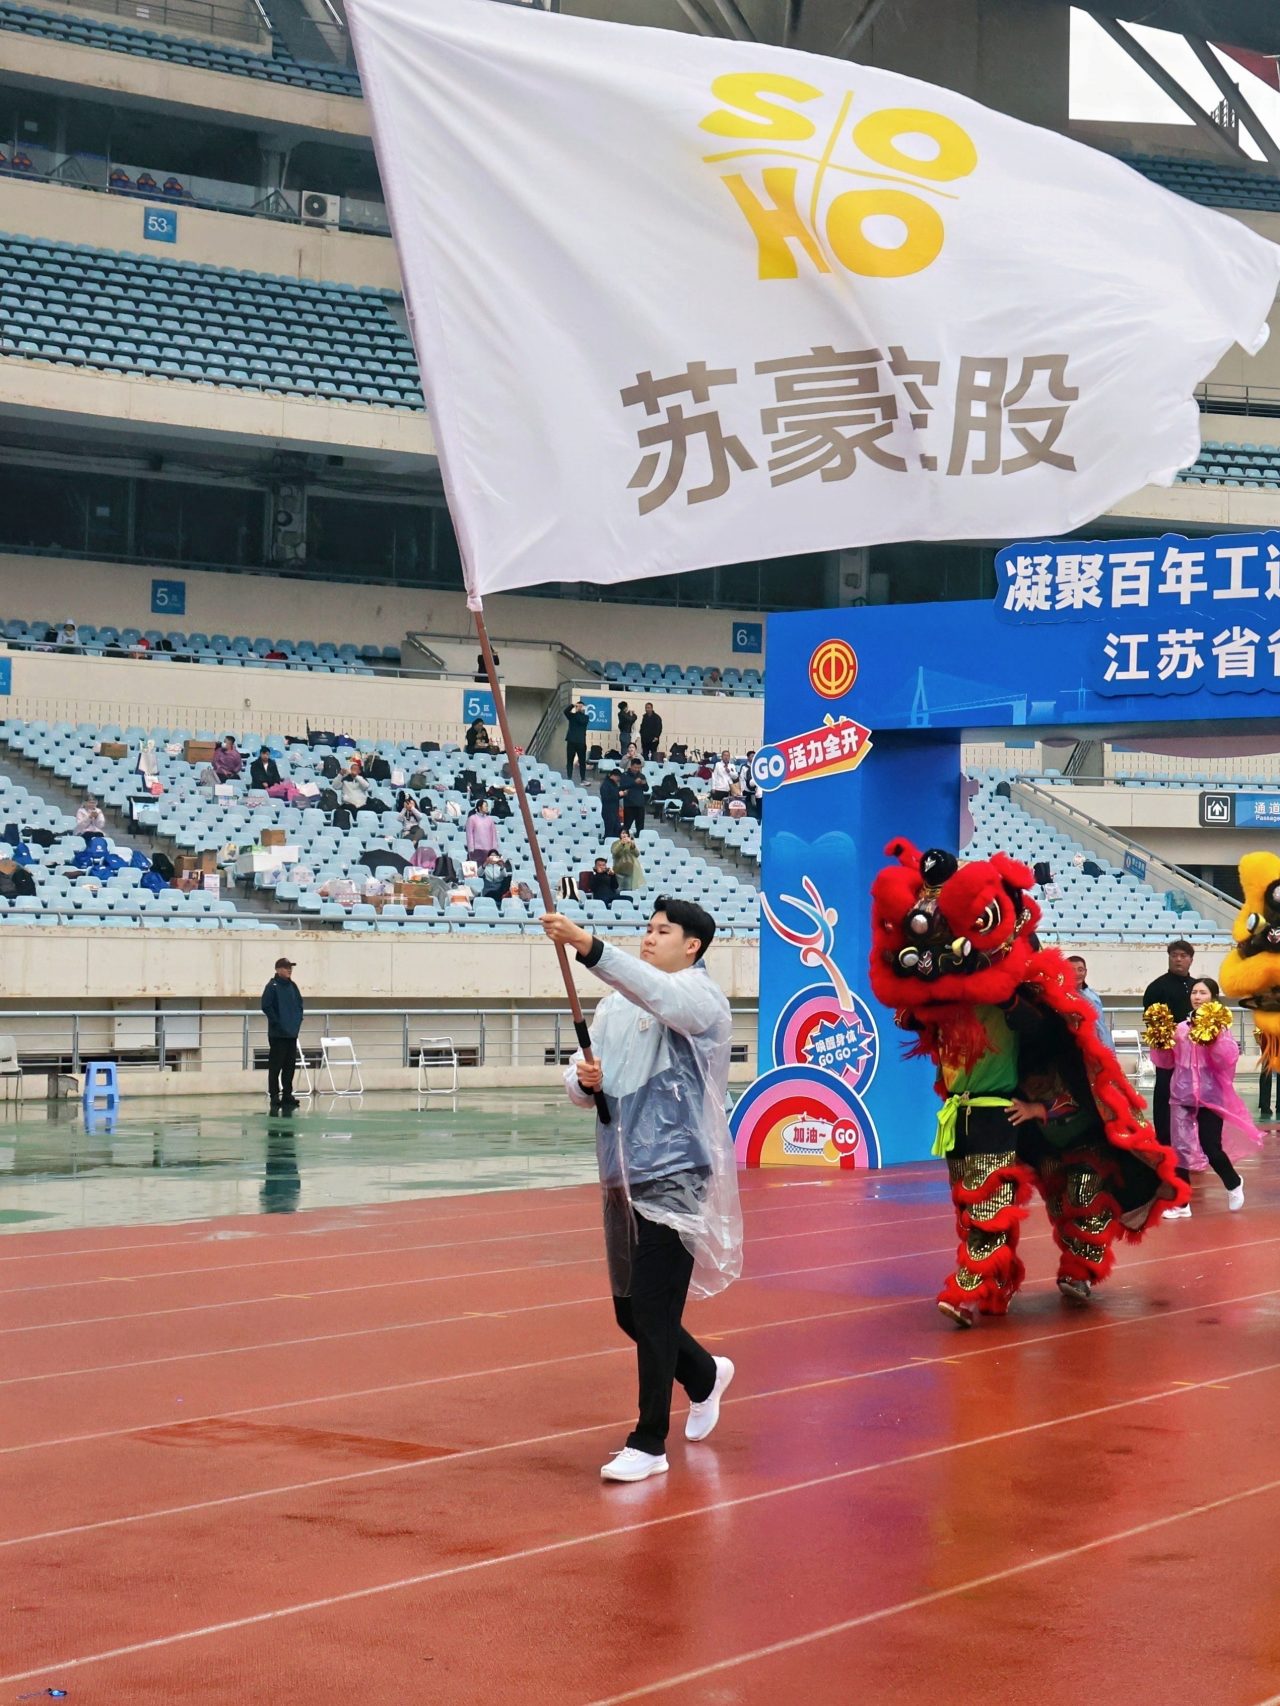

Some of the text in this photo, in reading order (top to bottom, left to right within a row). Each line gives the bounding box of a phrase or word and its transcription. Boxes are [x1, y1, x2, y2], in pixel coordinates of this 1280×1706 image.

[148, 216, 168, 233] 53
[156, 588, 169, 606] 5
[736, 629, 748, 646] 6
[788, 726, 859, 771] 活力全开
[754, 754, 785, 780] GO
[1254, 801, 1280, 814] 通道
[815, 1030, 857, 1053] 唤醒身体
[819, 1053, 834, 1067] GO
[835, 1128, 856, 1144] GO
